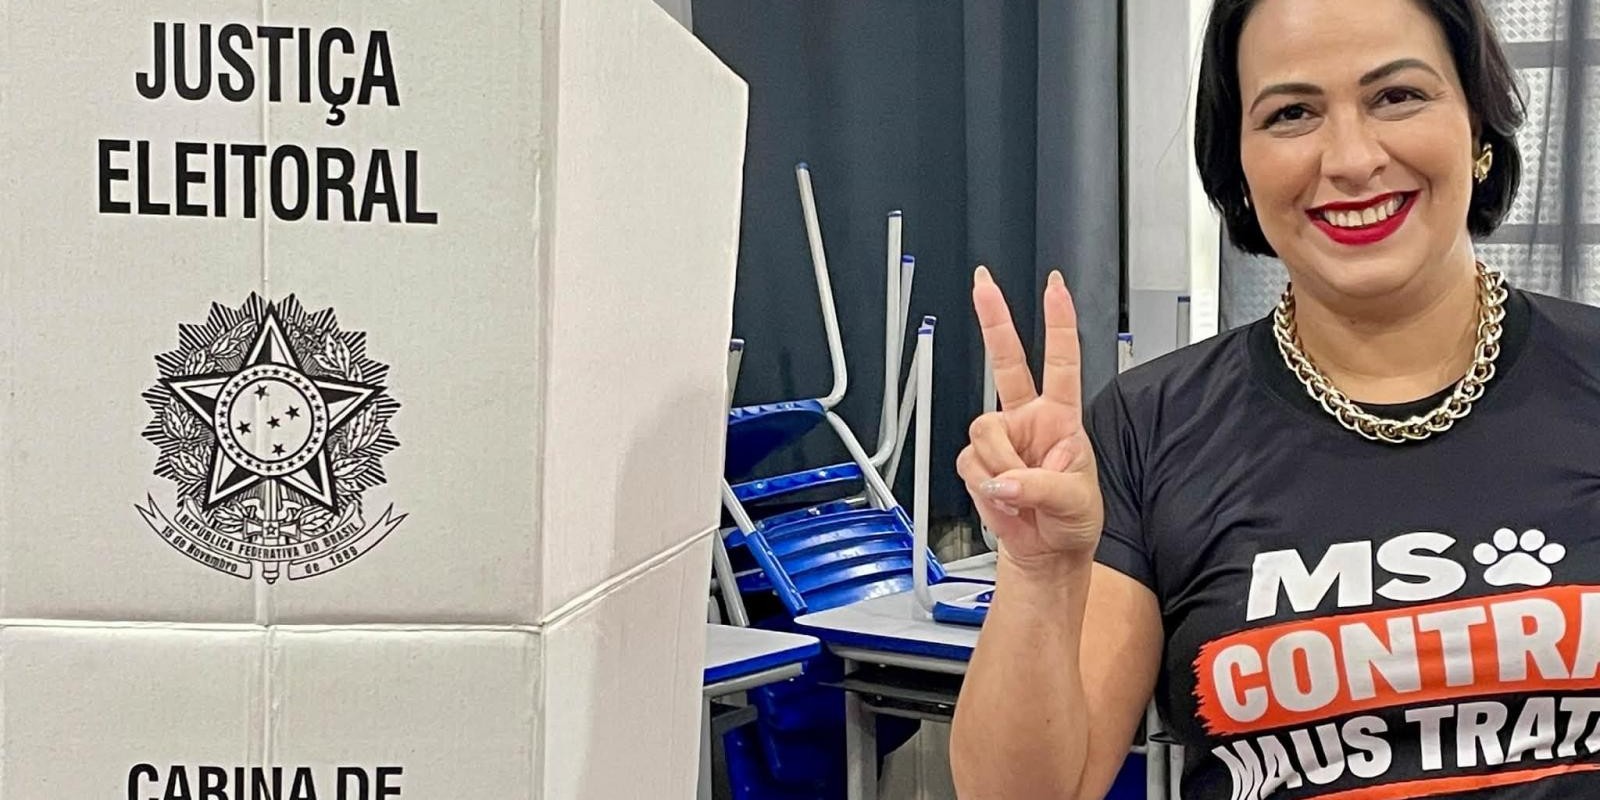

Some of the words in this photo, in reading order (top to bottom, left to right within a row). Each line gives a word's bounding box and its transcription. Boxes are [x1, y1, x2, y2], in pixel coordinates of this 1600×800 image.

[136, 22, 400, 126] JUSTIÇA
[98, 139, 438, 225] ELEITORAL
[161, 526, 173, 538] 15
[186, 543, 238, 573] Novembro
[239, 544, 300, 560] FEDERATIVA
[304, 541, 319, 555] DO
[322, 522, 359, 547] BRASIL
[1246, 532, 1466, 621] MS
[1211, 715, 1393, 800] MAUS
[1405, 697, 1600, 771] TRAT
